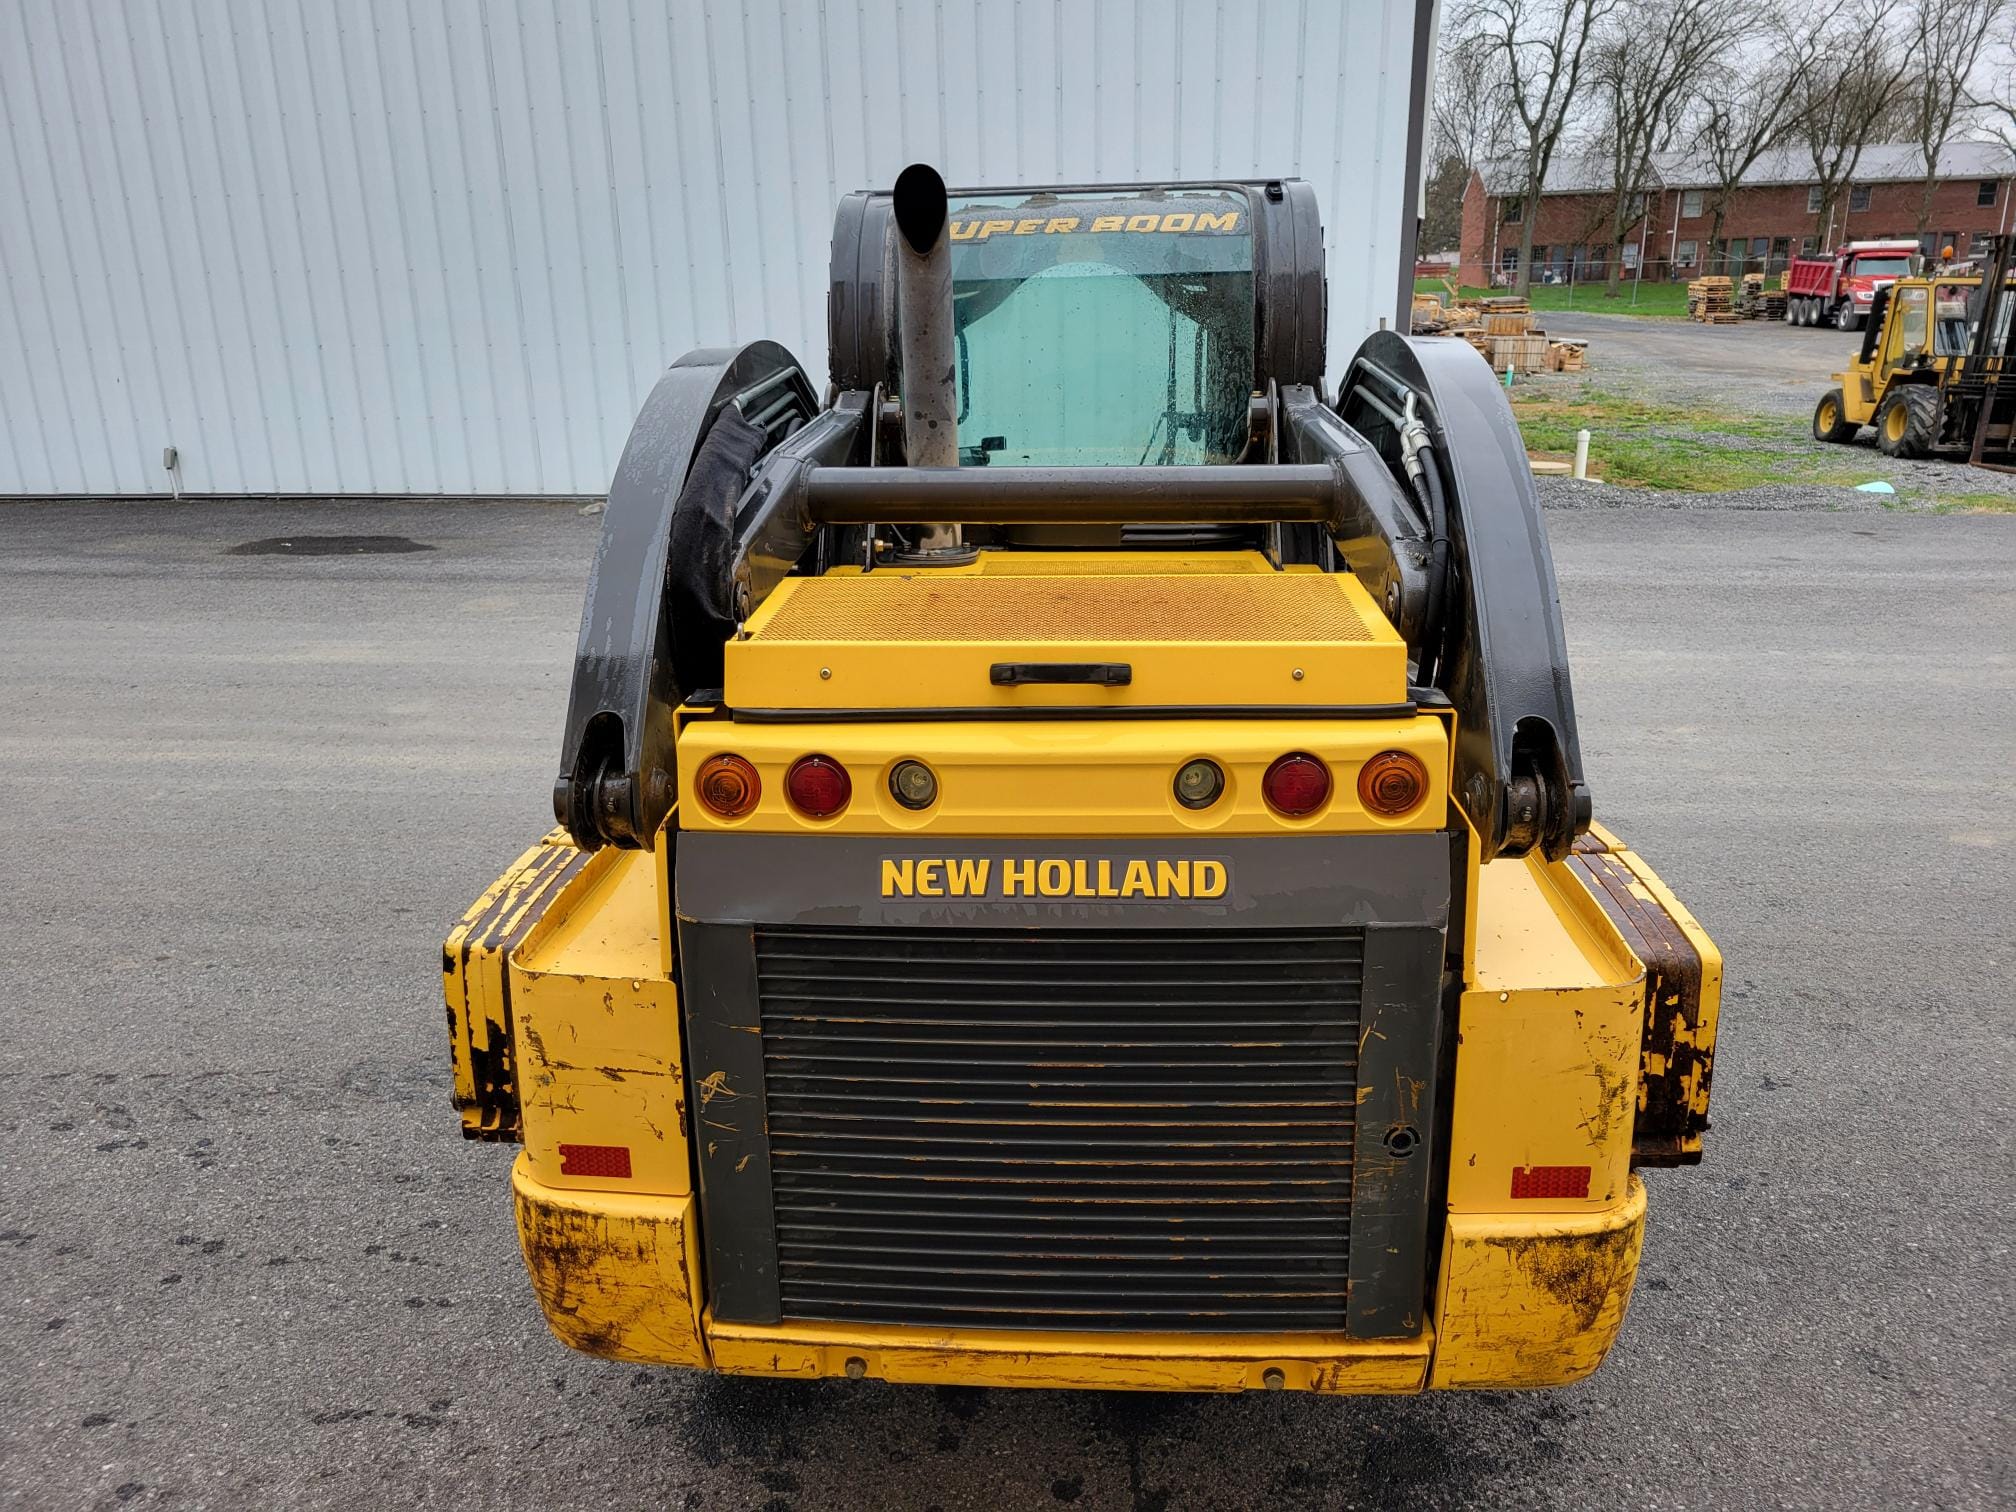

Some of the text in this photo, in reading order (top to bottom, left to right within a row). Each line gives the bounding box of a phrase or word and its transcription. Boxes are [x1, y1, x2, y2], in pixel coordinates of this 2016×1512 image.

[949, 212, 1239, 240] UPER BOOM
[881, 859, 1228, 898] NEW HOLLAND
